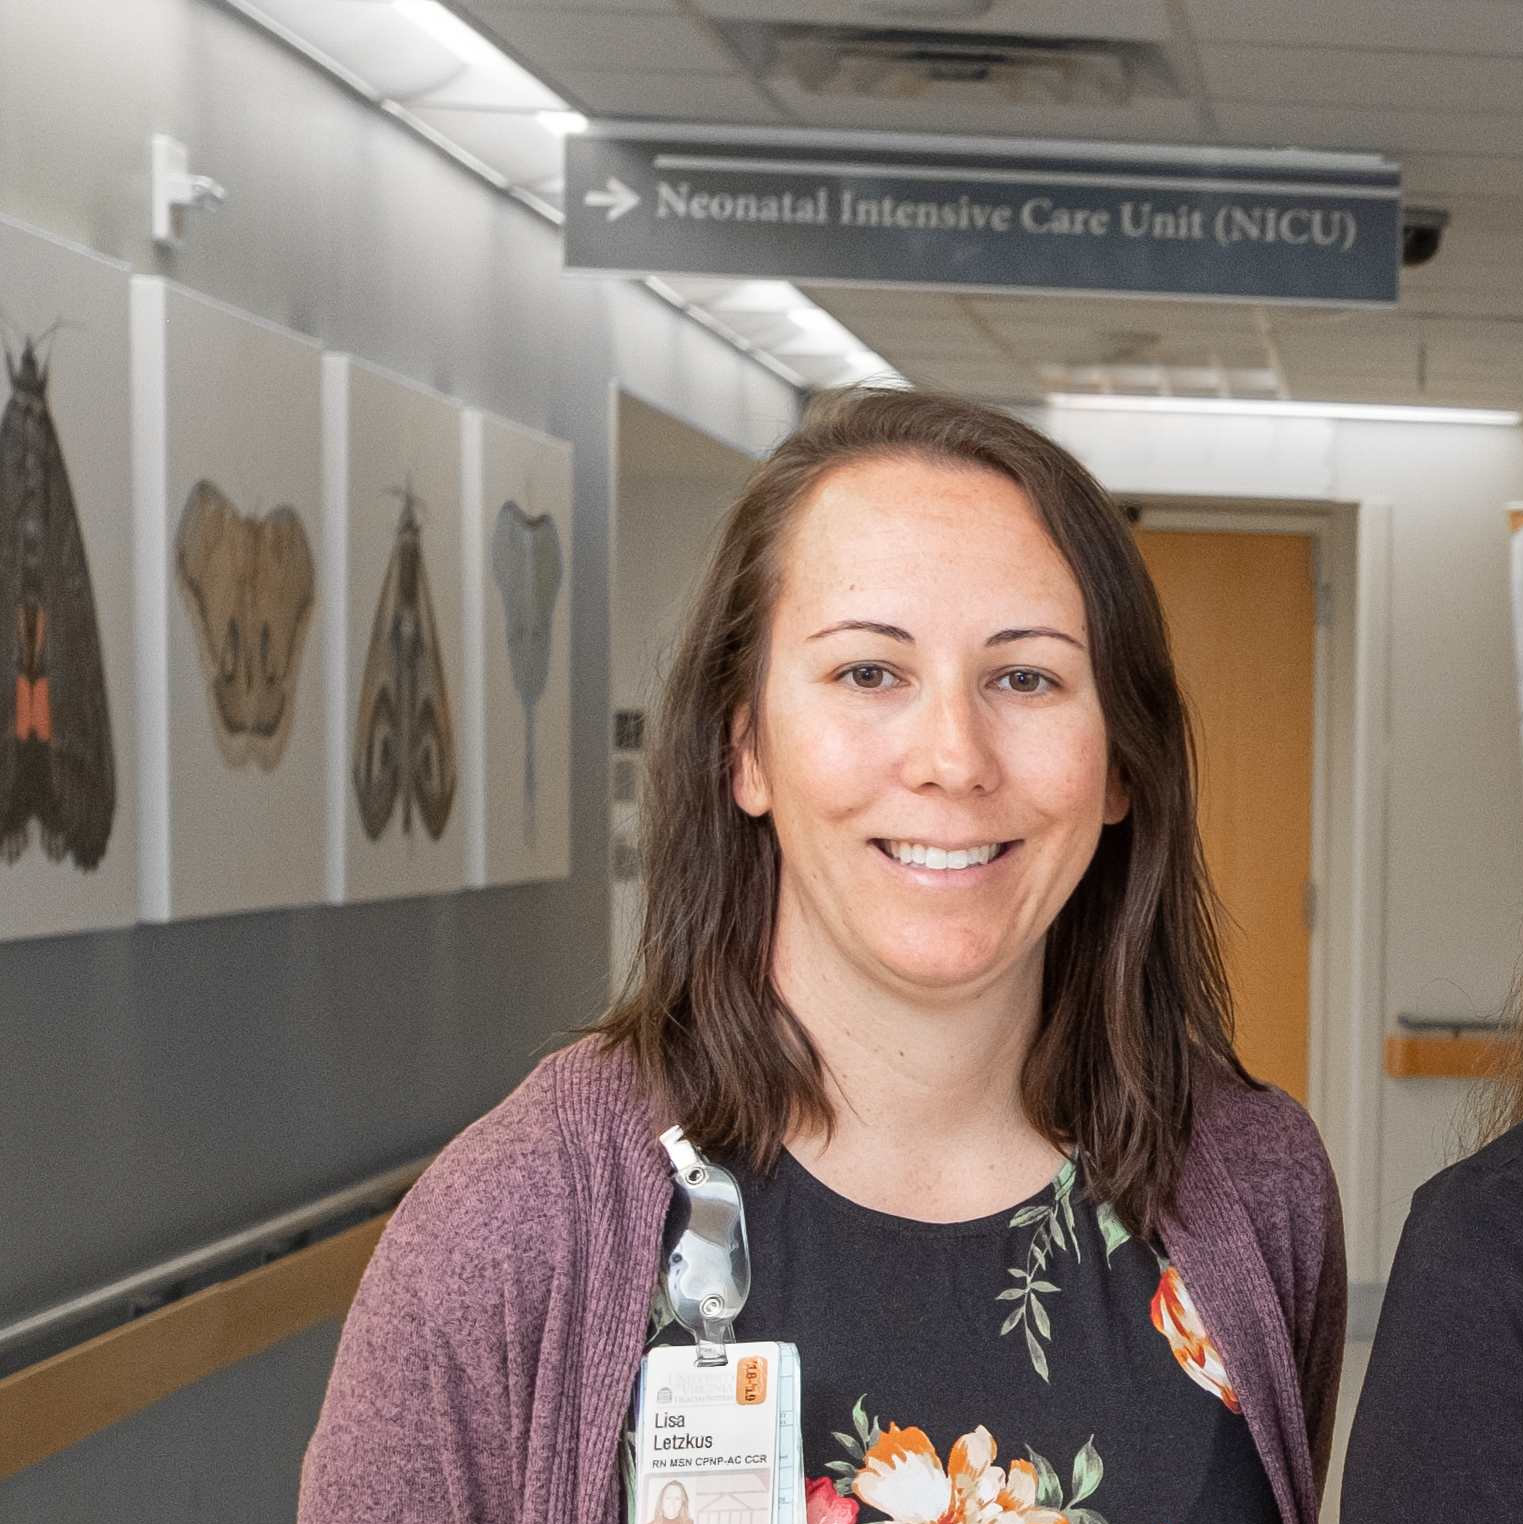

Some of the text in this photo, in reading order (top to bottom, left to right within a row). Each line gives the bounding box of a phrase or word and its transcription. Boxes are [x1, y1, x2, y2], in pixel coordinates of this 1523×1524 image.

[656, 181, 1357, 251] Neonatal Intensive Care Unit (NICU)
[655, 1412, 685, 1428] Lisa
[654, 1433, 713, 1450] Letzkus
[652, 1459, 666, 1468] RN
